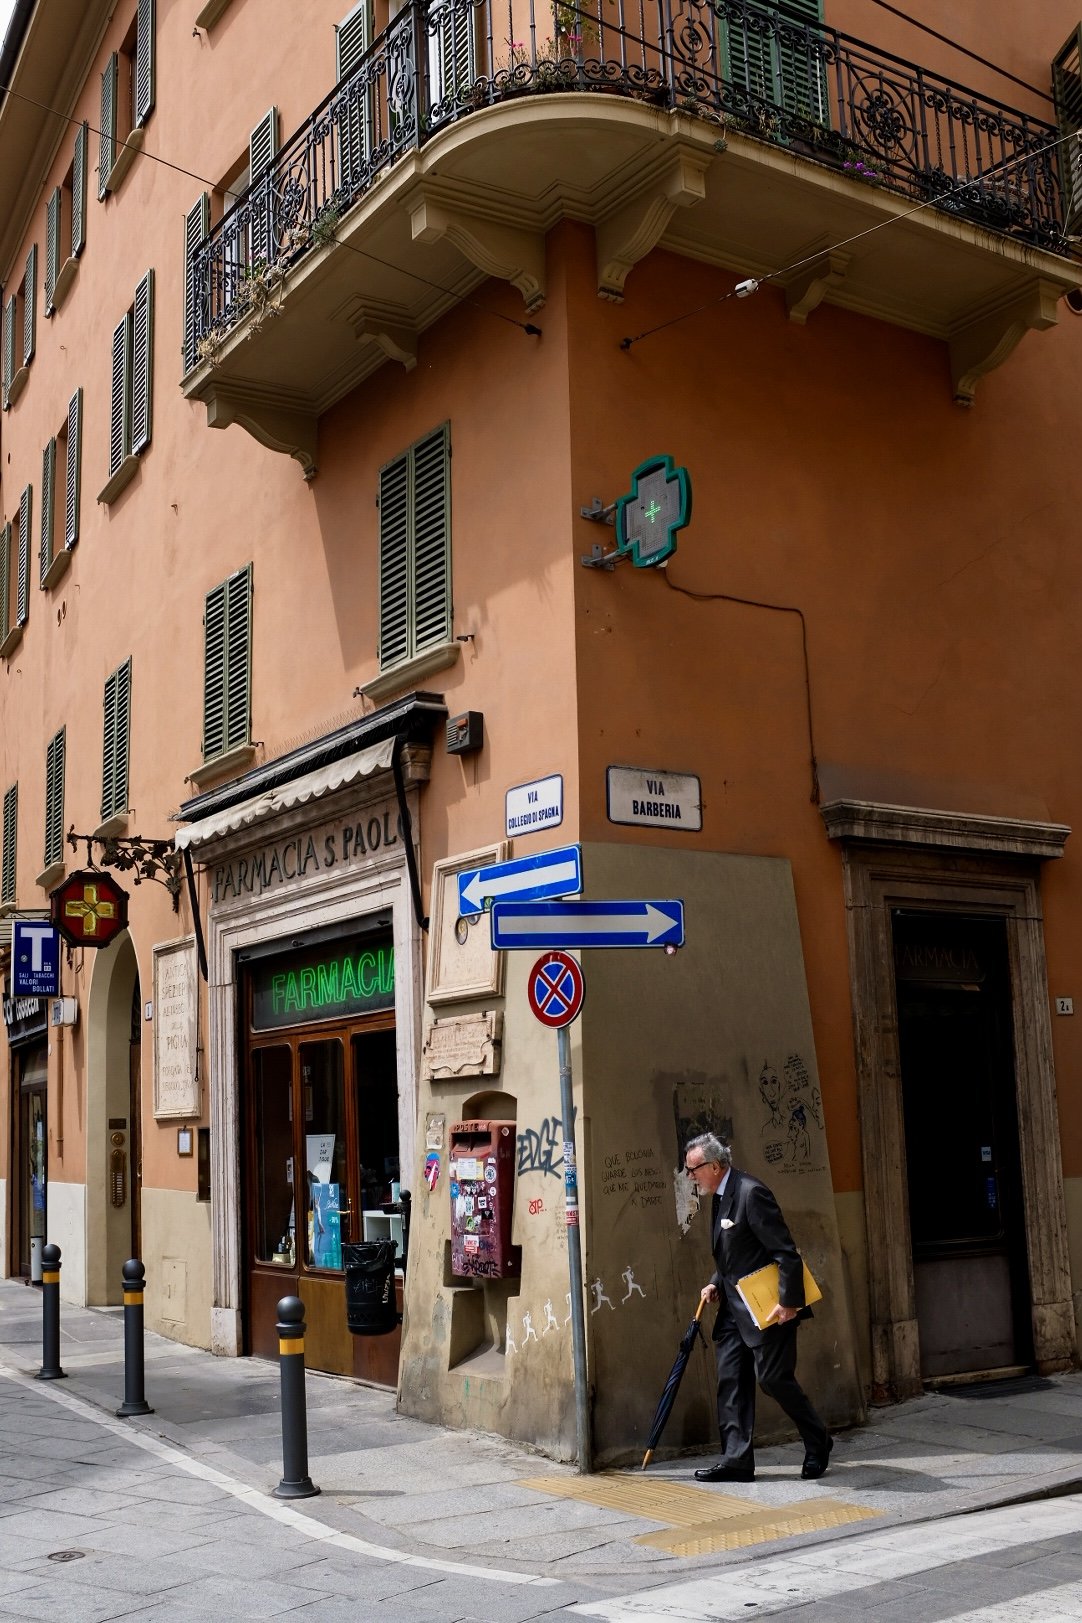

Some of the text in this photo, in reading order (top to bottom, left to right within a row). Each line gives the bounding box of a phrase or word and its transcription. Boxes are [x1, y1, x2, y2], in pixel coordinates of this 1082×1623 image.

[527, 790, 539, 804] VIA
[646, 780, 665, 796] VIA
[508, 805, 560, 829] COLLEGIO DI SPAGNA
[632, 799, 682, 820] BARBERIA
[213, 834, 320, 903] FARMACIA
[324, 834, 339, 868] S.
[20, 927, 54, 971] T
[32, 985, 55, 993] BOLLATI
